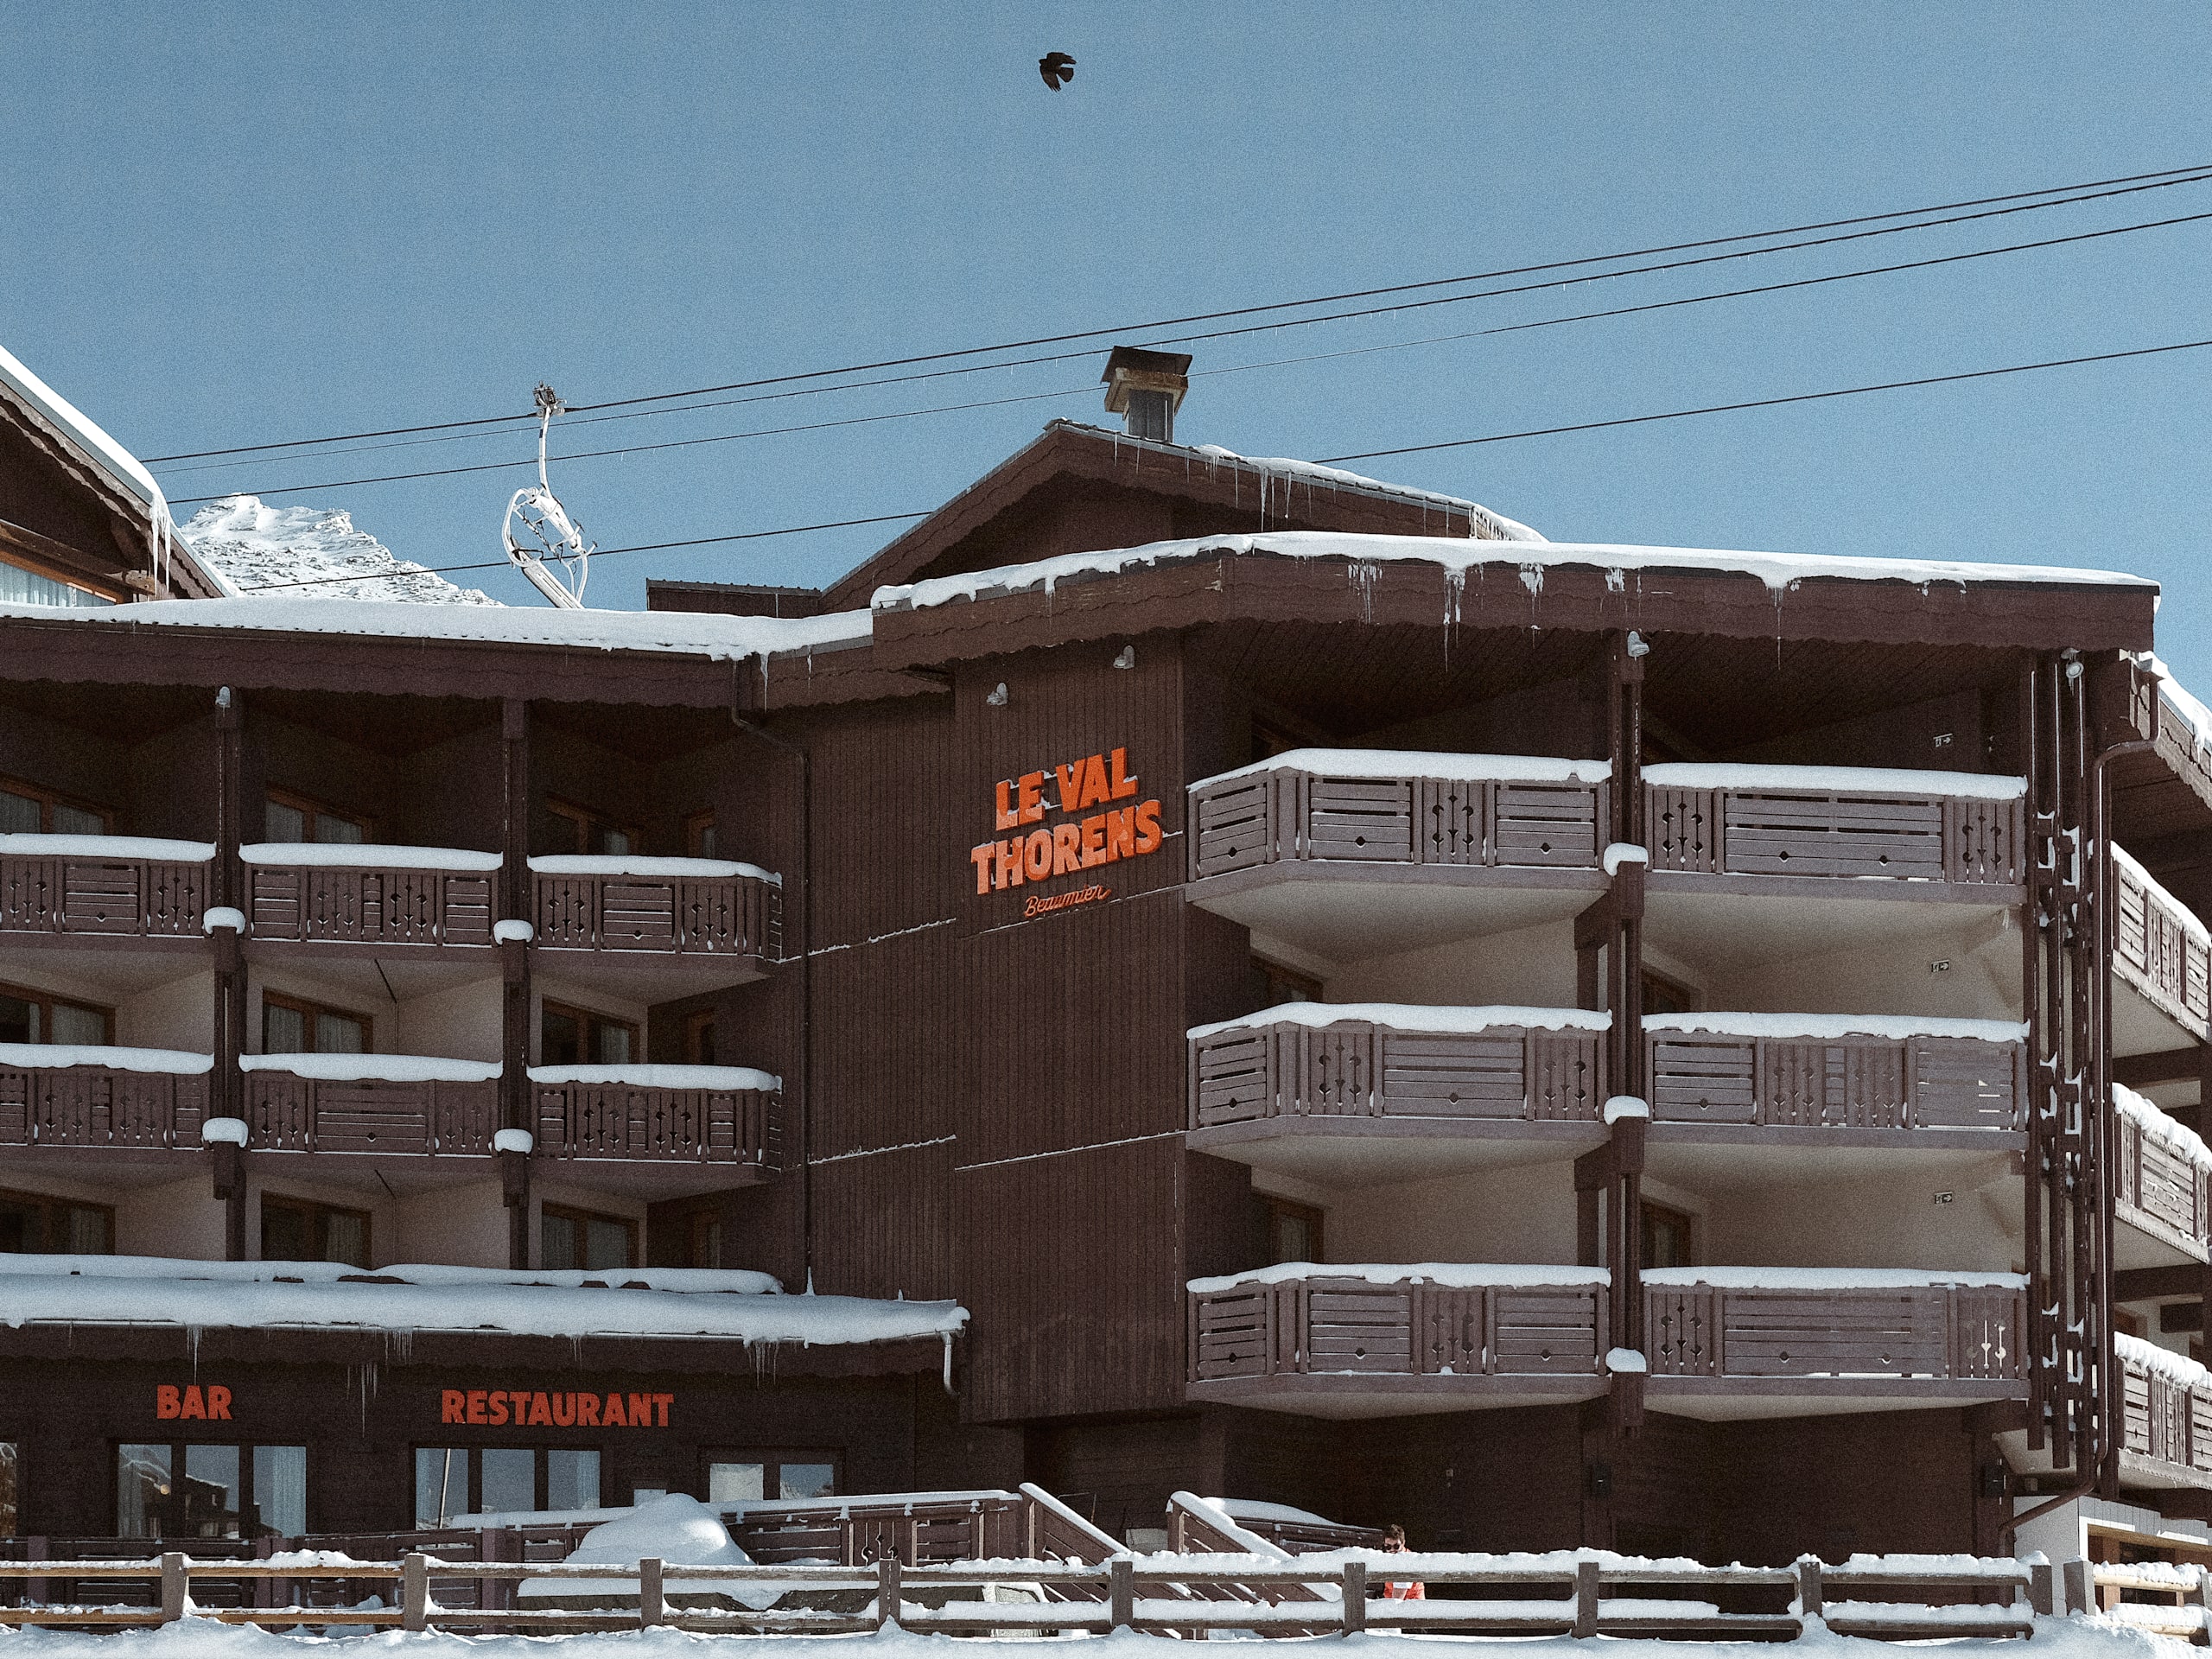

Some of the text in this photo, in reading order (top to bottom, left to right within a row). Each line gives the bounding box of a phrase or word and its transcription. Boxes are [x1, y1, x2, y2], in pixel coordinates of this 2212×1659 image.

[995, 747, 1139, 831] LE VAL
[970, 799, 1163, 895] THORENS
[1024, 884, 1112, 918] Beaumier
[156, 1384, 232, 1421] BAR
[441, 1389, 675, 1427] RESTAURANT
